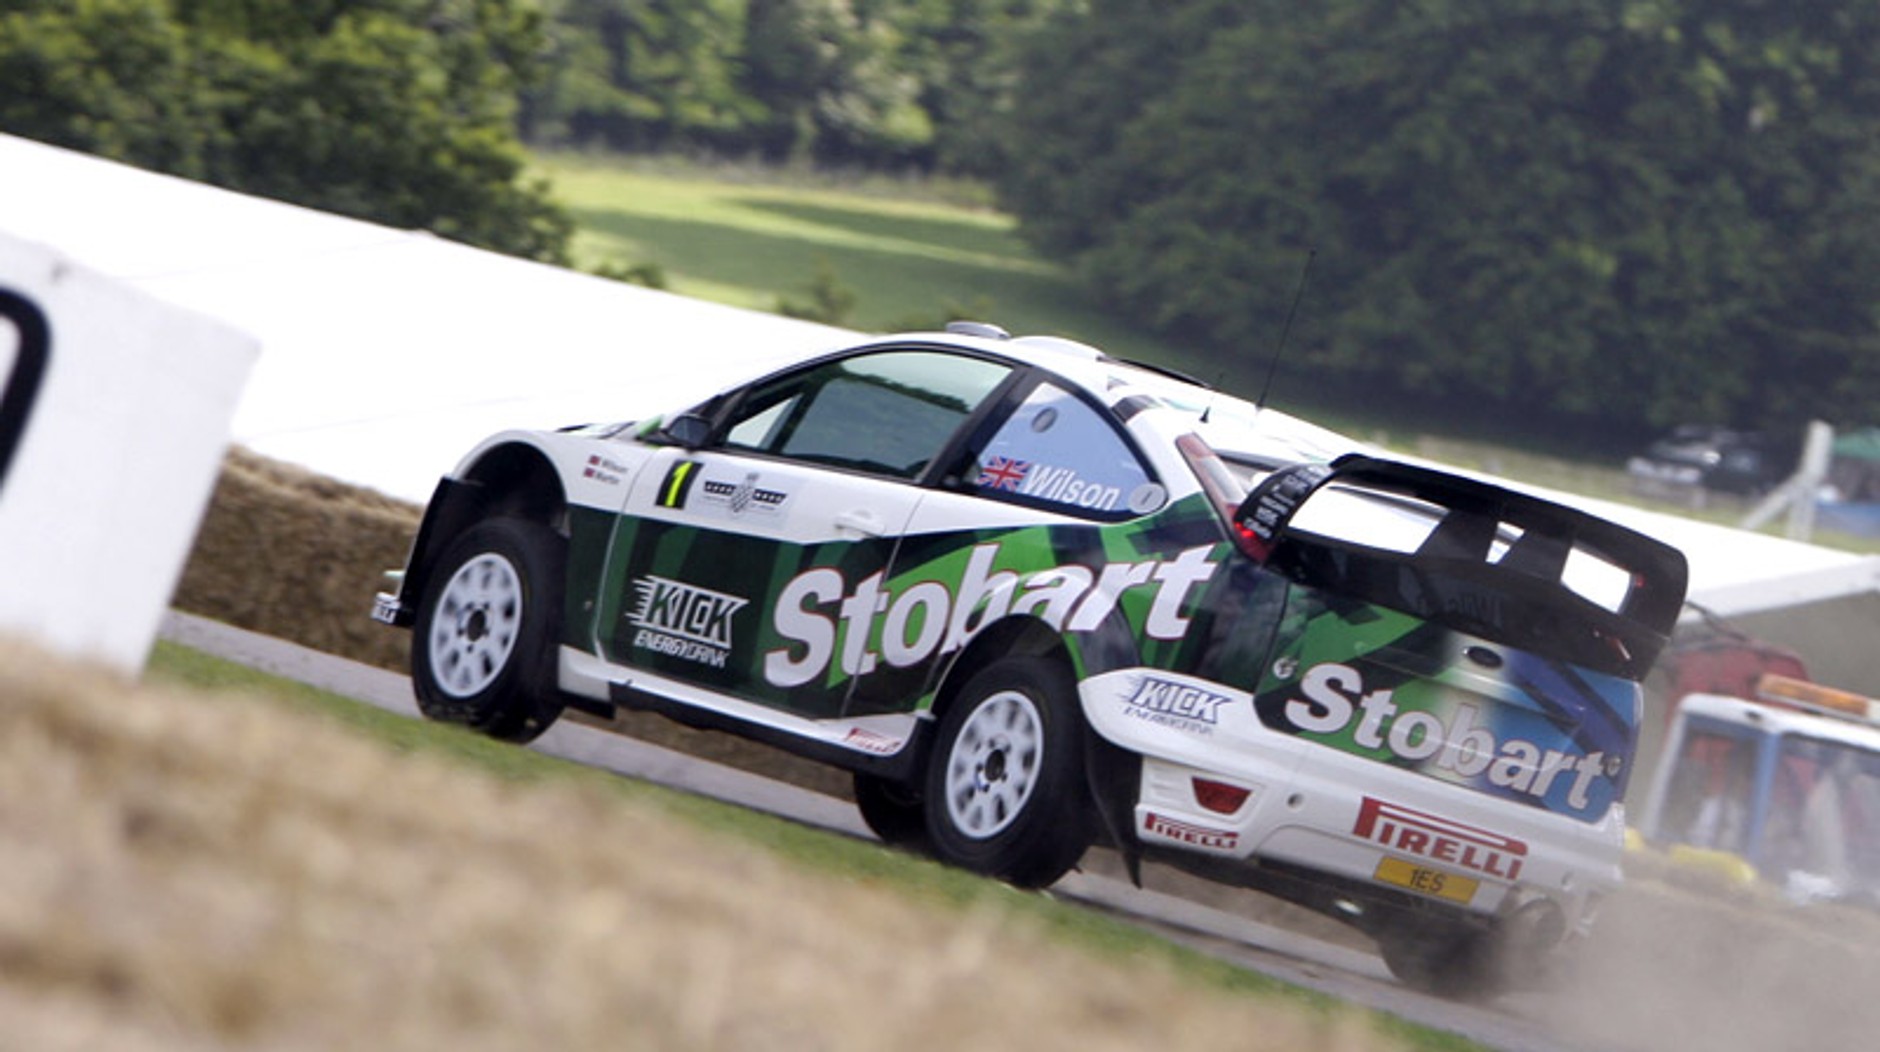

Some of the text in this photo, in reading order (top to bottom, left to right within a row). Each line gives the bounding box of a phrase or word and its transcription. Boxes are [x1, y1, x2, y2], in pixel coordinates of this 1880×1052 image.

[1022, 464, 1120, 510] Wilson
[638, 576, 742, 648] KICK
[763, 543, 1220, 687] Stobart
[1130, 677, 1229, 724] KICK
[1285, 663, 1604, 810] Stobart
[1145, 812, 1239, 849] PIRELLI
[1352, 796, 1529, 881] PIRELLI
